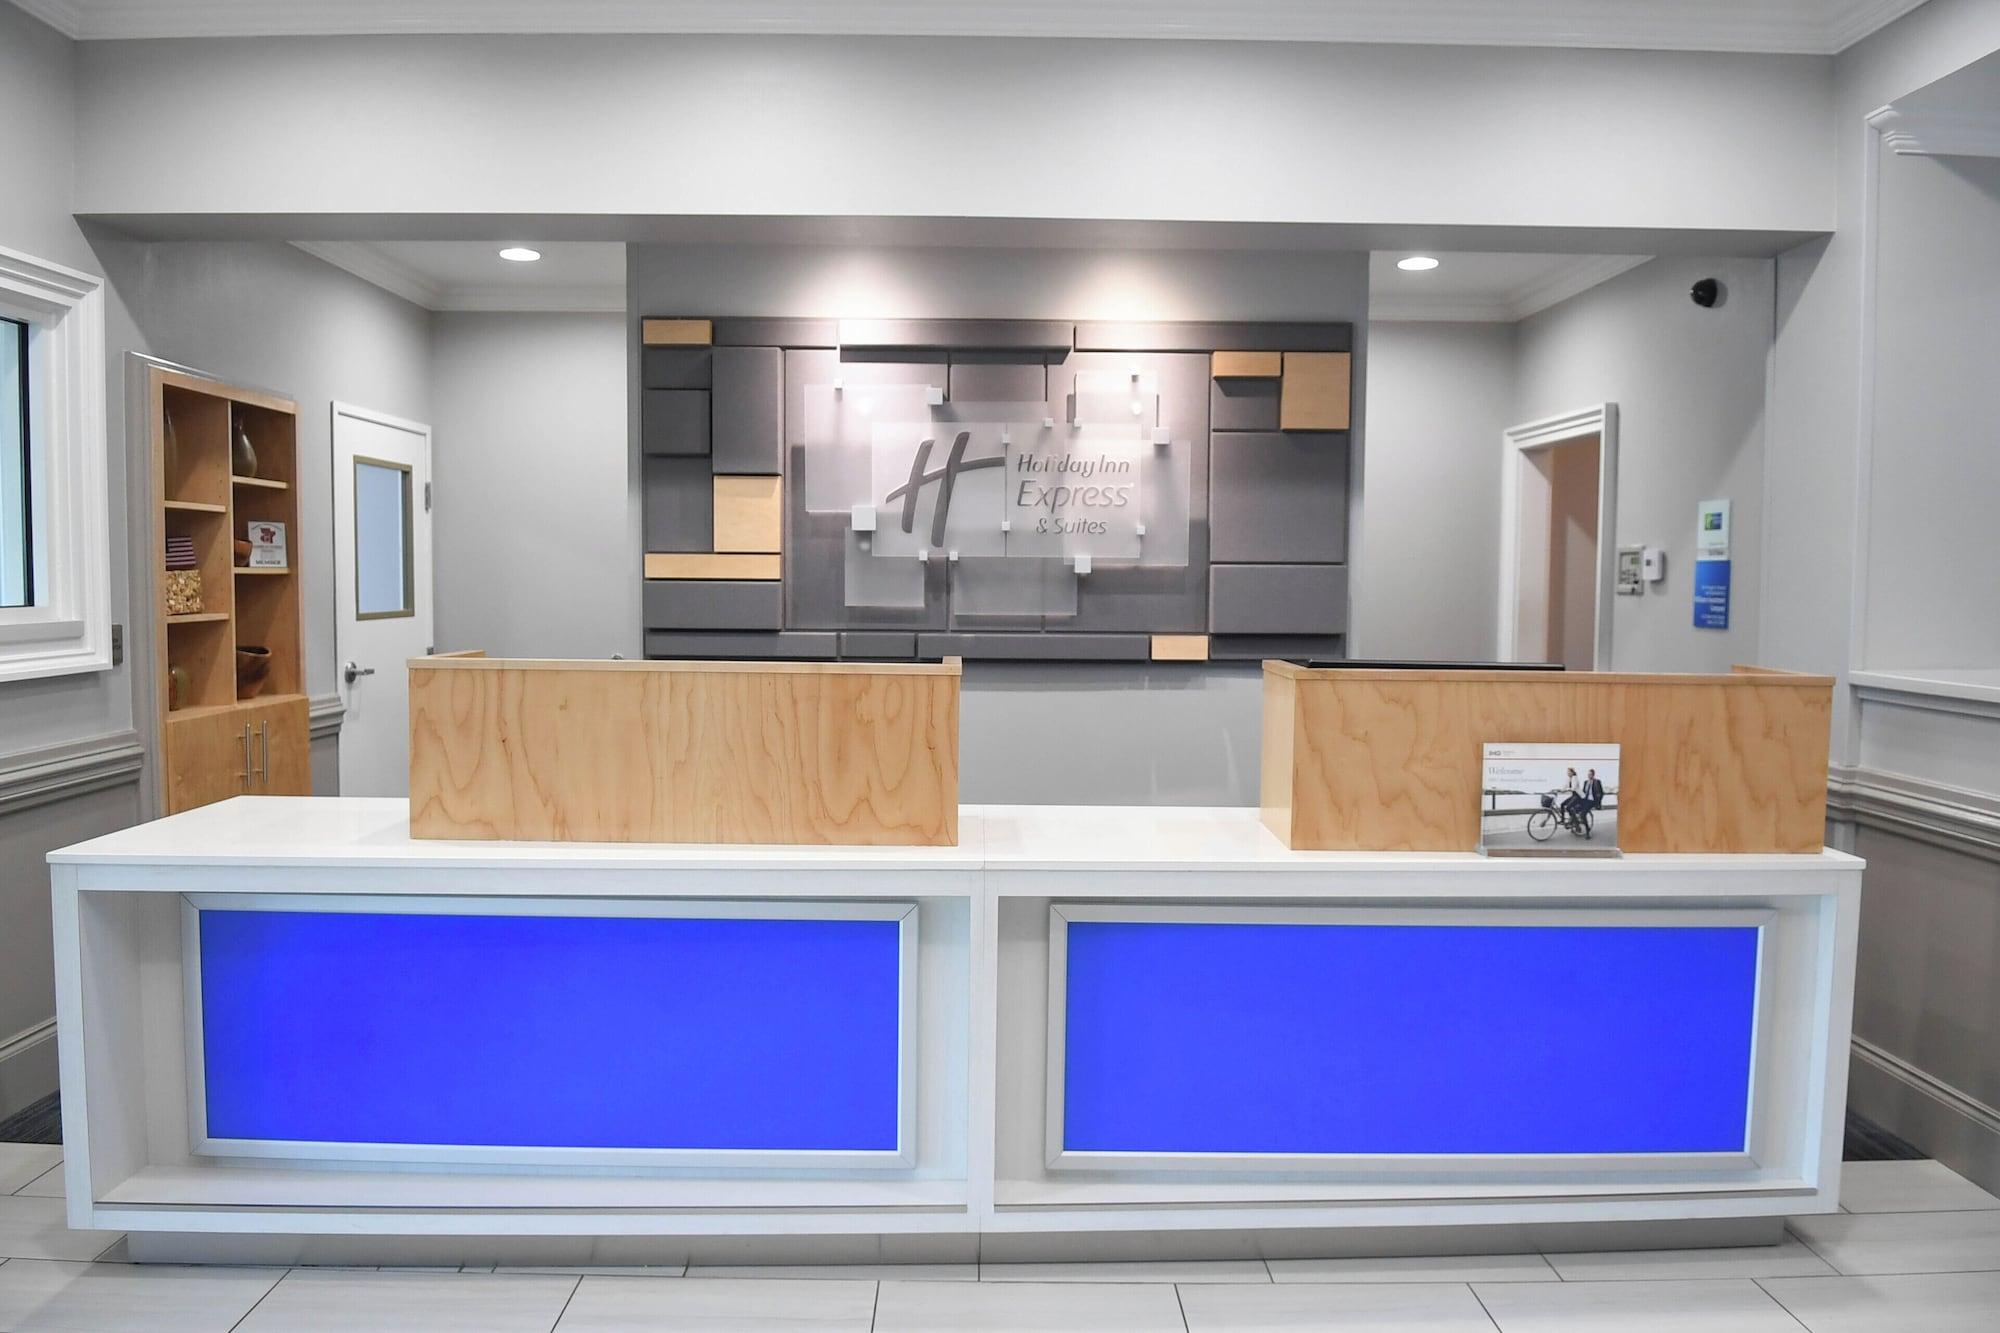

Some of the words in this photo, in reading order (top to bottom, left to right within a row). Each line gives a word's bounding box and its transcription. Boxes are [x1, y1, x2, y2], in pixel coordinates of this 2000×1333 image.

[1017, 453, 1094, 477] Holiday
[1099, 454, 1130, 473] Inn
[1016, 479, 1130, 514] Express
[1036, 517, 1048, 535] &
[1054, 517, 1107, 535] Suites
